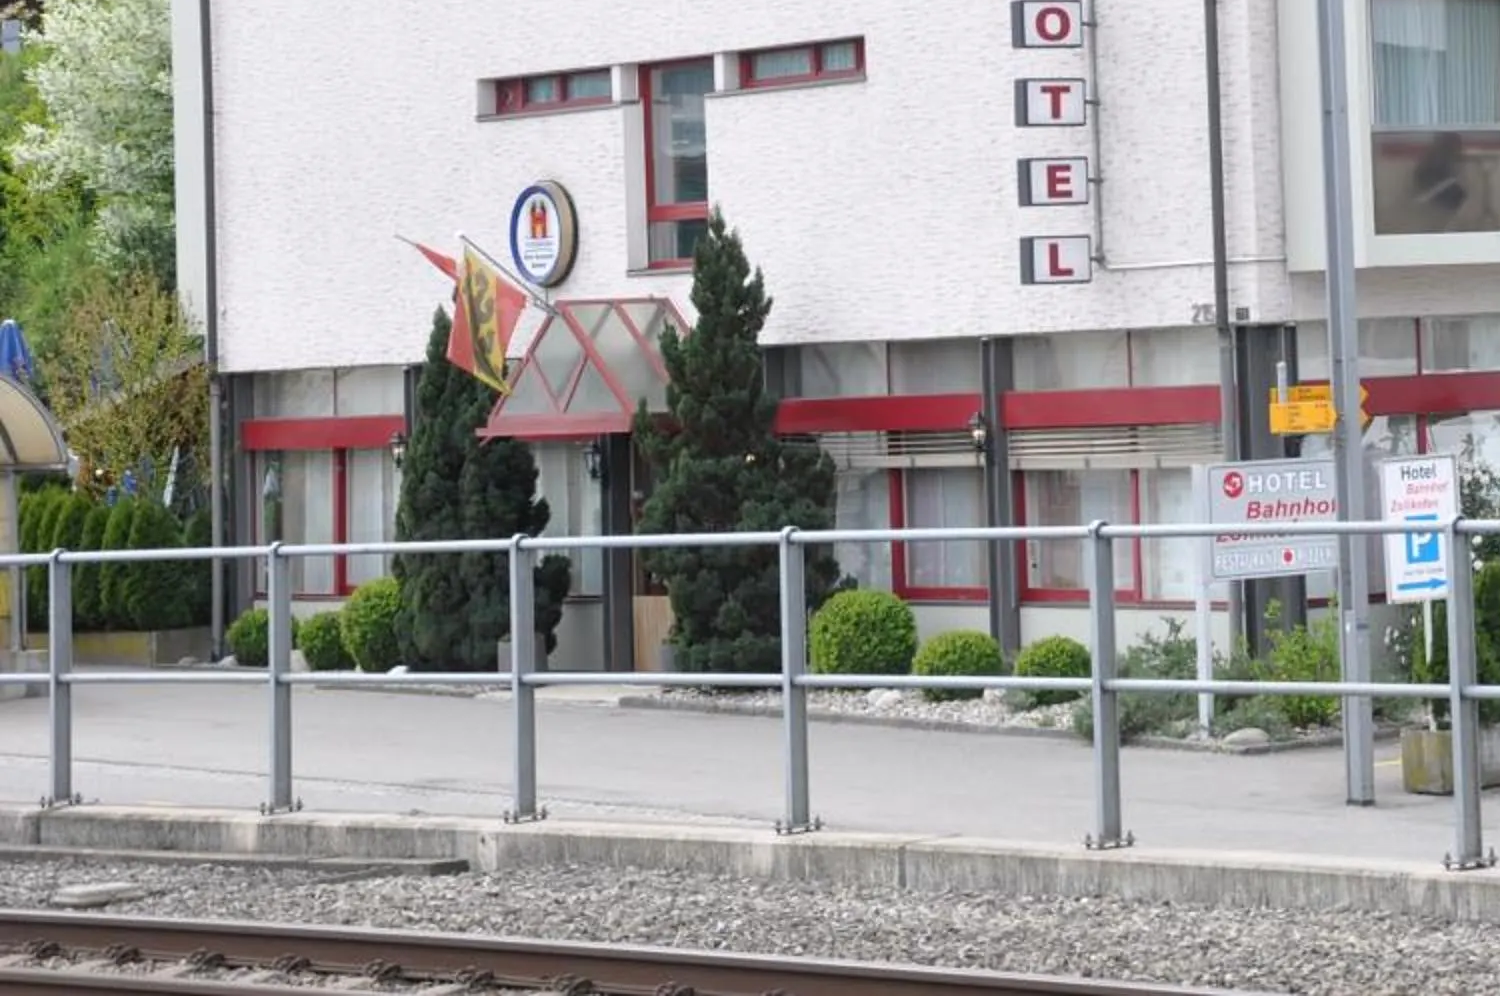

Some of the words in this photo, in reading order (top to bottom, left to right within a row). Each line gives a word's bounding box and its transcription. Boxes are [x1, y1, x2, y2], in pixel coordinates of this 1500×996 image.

[1248, 471, 1327, 493] HOTEL
[1401, 464, 1438, 481] Hotel
[1411, 529, 1434, 558] P
